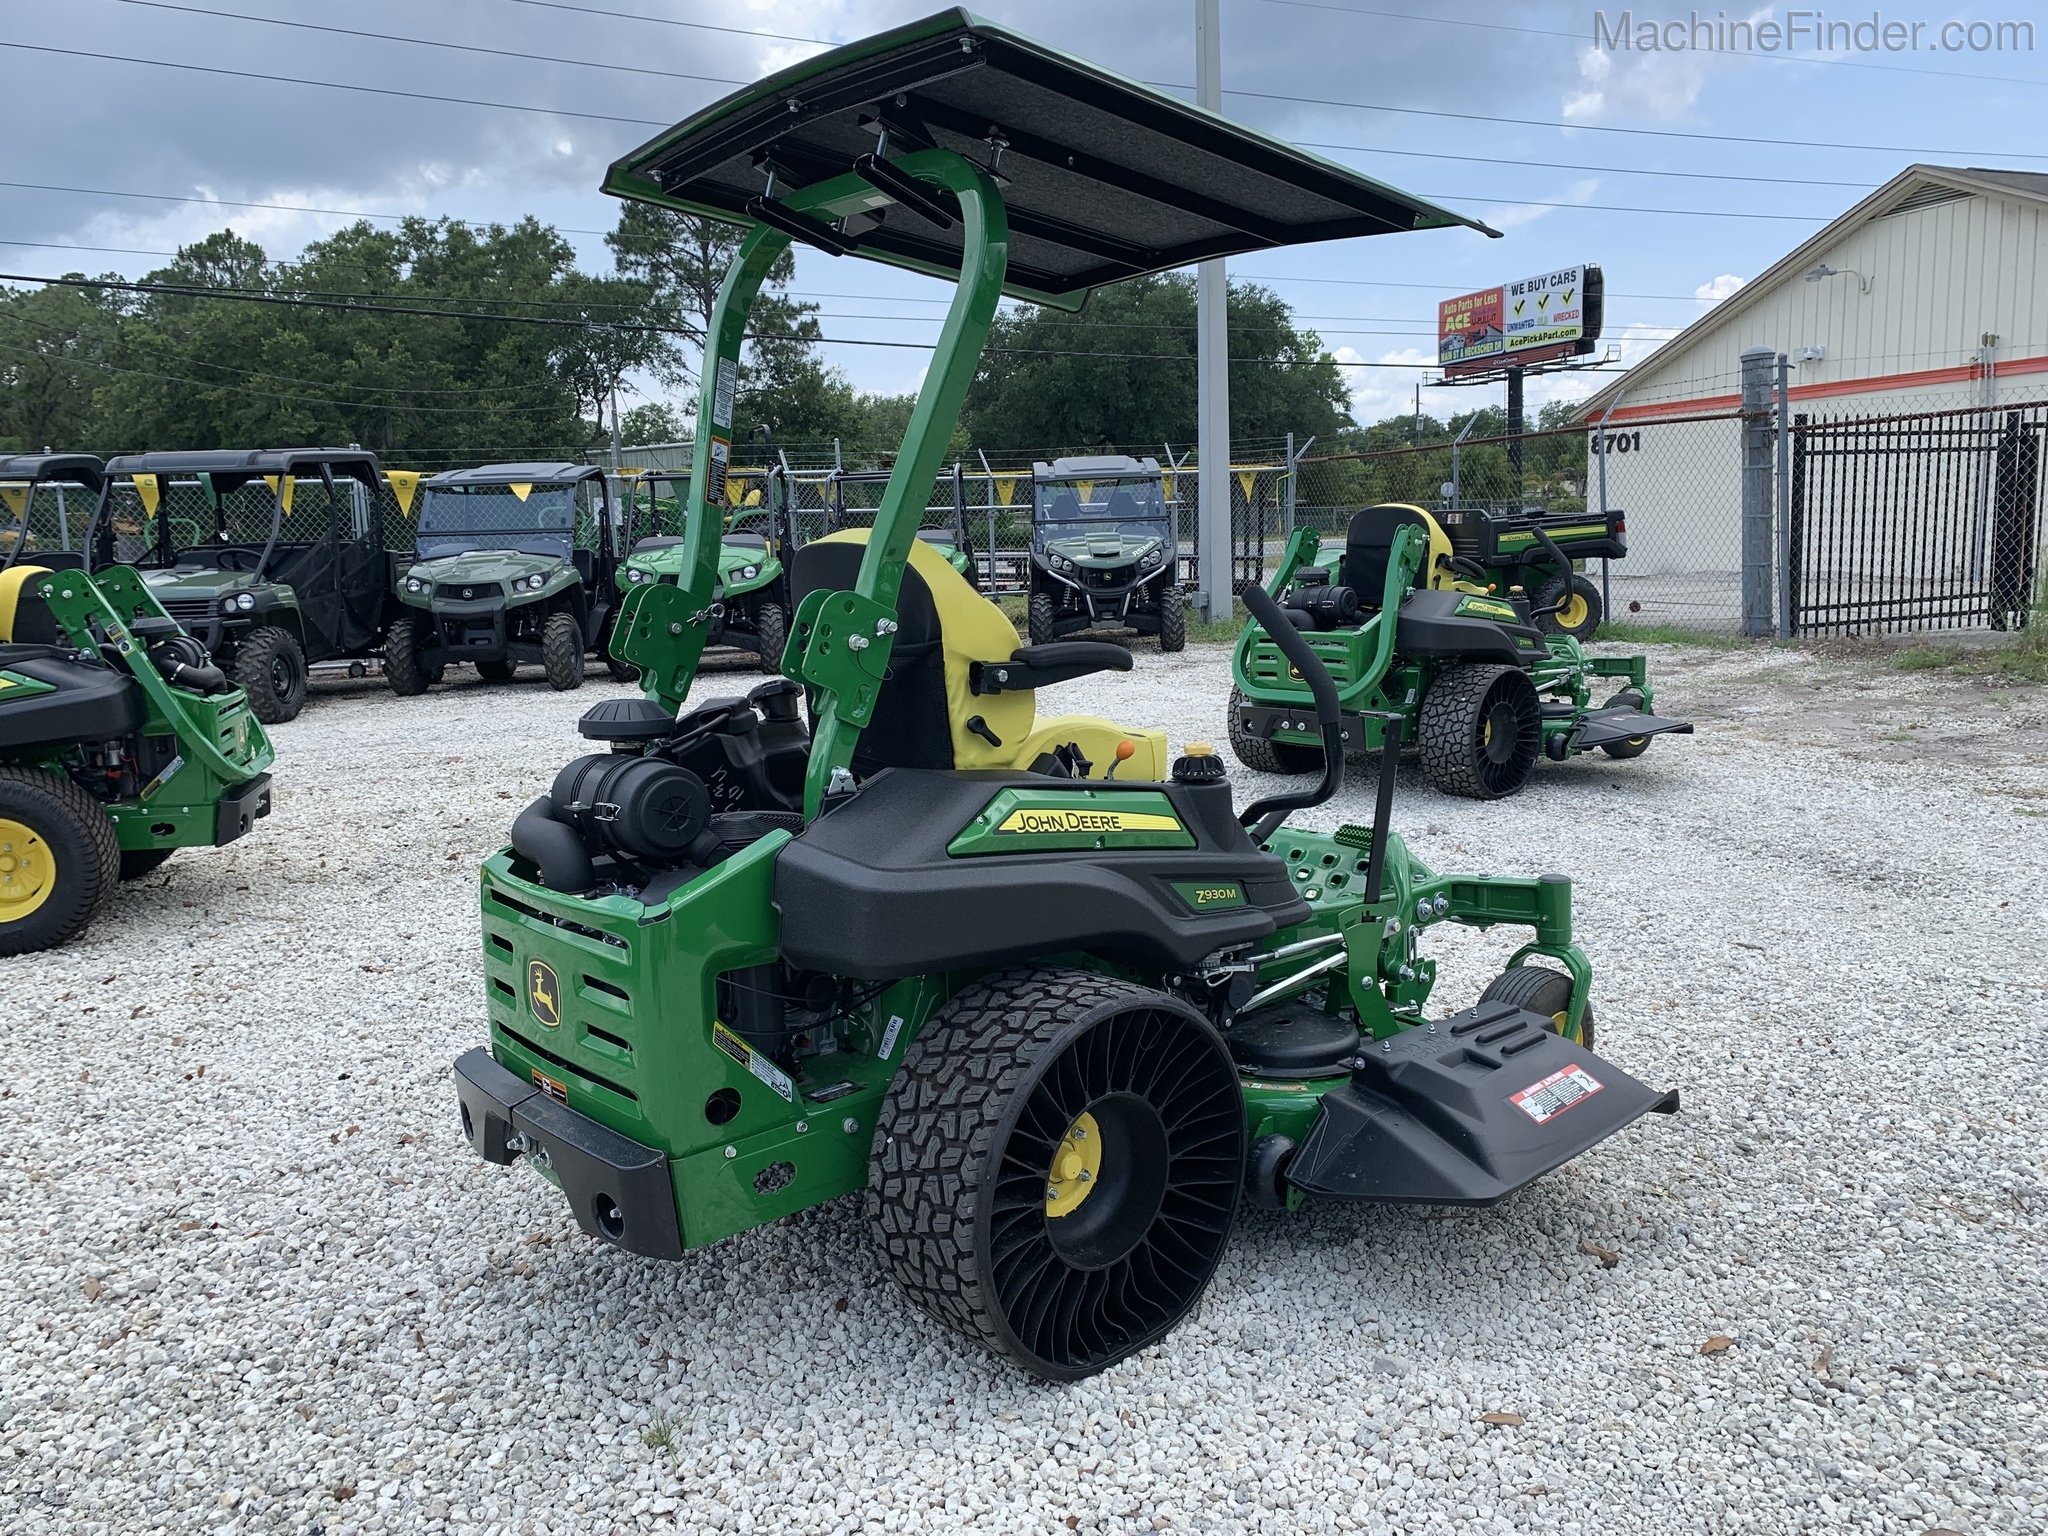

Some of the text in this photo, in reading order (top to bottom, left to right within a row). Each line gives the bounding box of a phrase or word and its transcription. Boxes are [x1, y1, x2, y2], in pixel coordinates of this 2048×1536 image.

[1511, 270, 1577, 297] WE BUY CARS
[1444, 293, 1498, 315] Auto Parts for Less
[1444, 311, 1472, 332] ACE
[1506, 318, 1535, 333] UNWANTED
[1553, 309, 1580, 323] WRECKED
[1509, 328, 1577, 348] AcePickAPart.com
[1591, 431, 1640, 455] 8701
[1017, 812, 1122, 832] JOHN DEERE
[1195, 888, 1237, 904] Z930M
